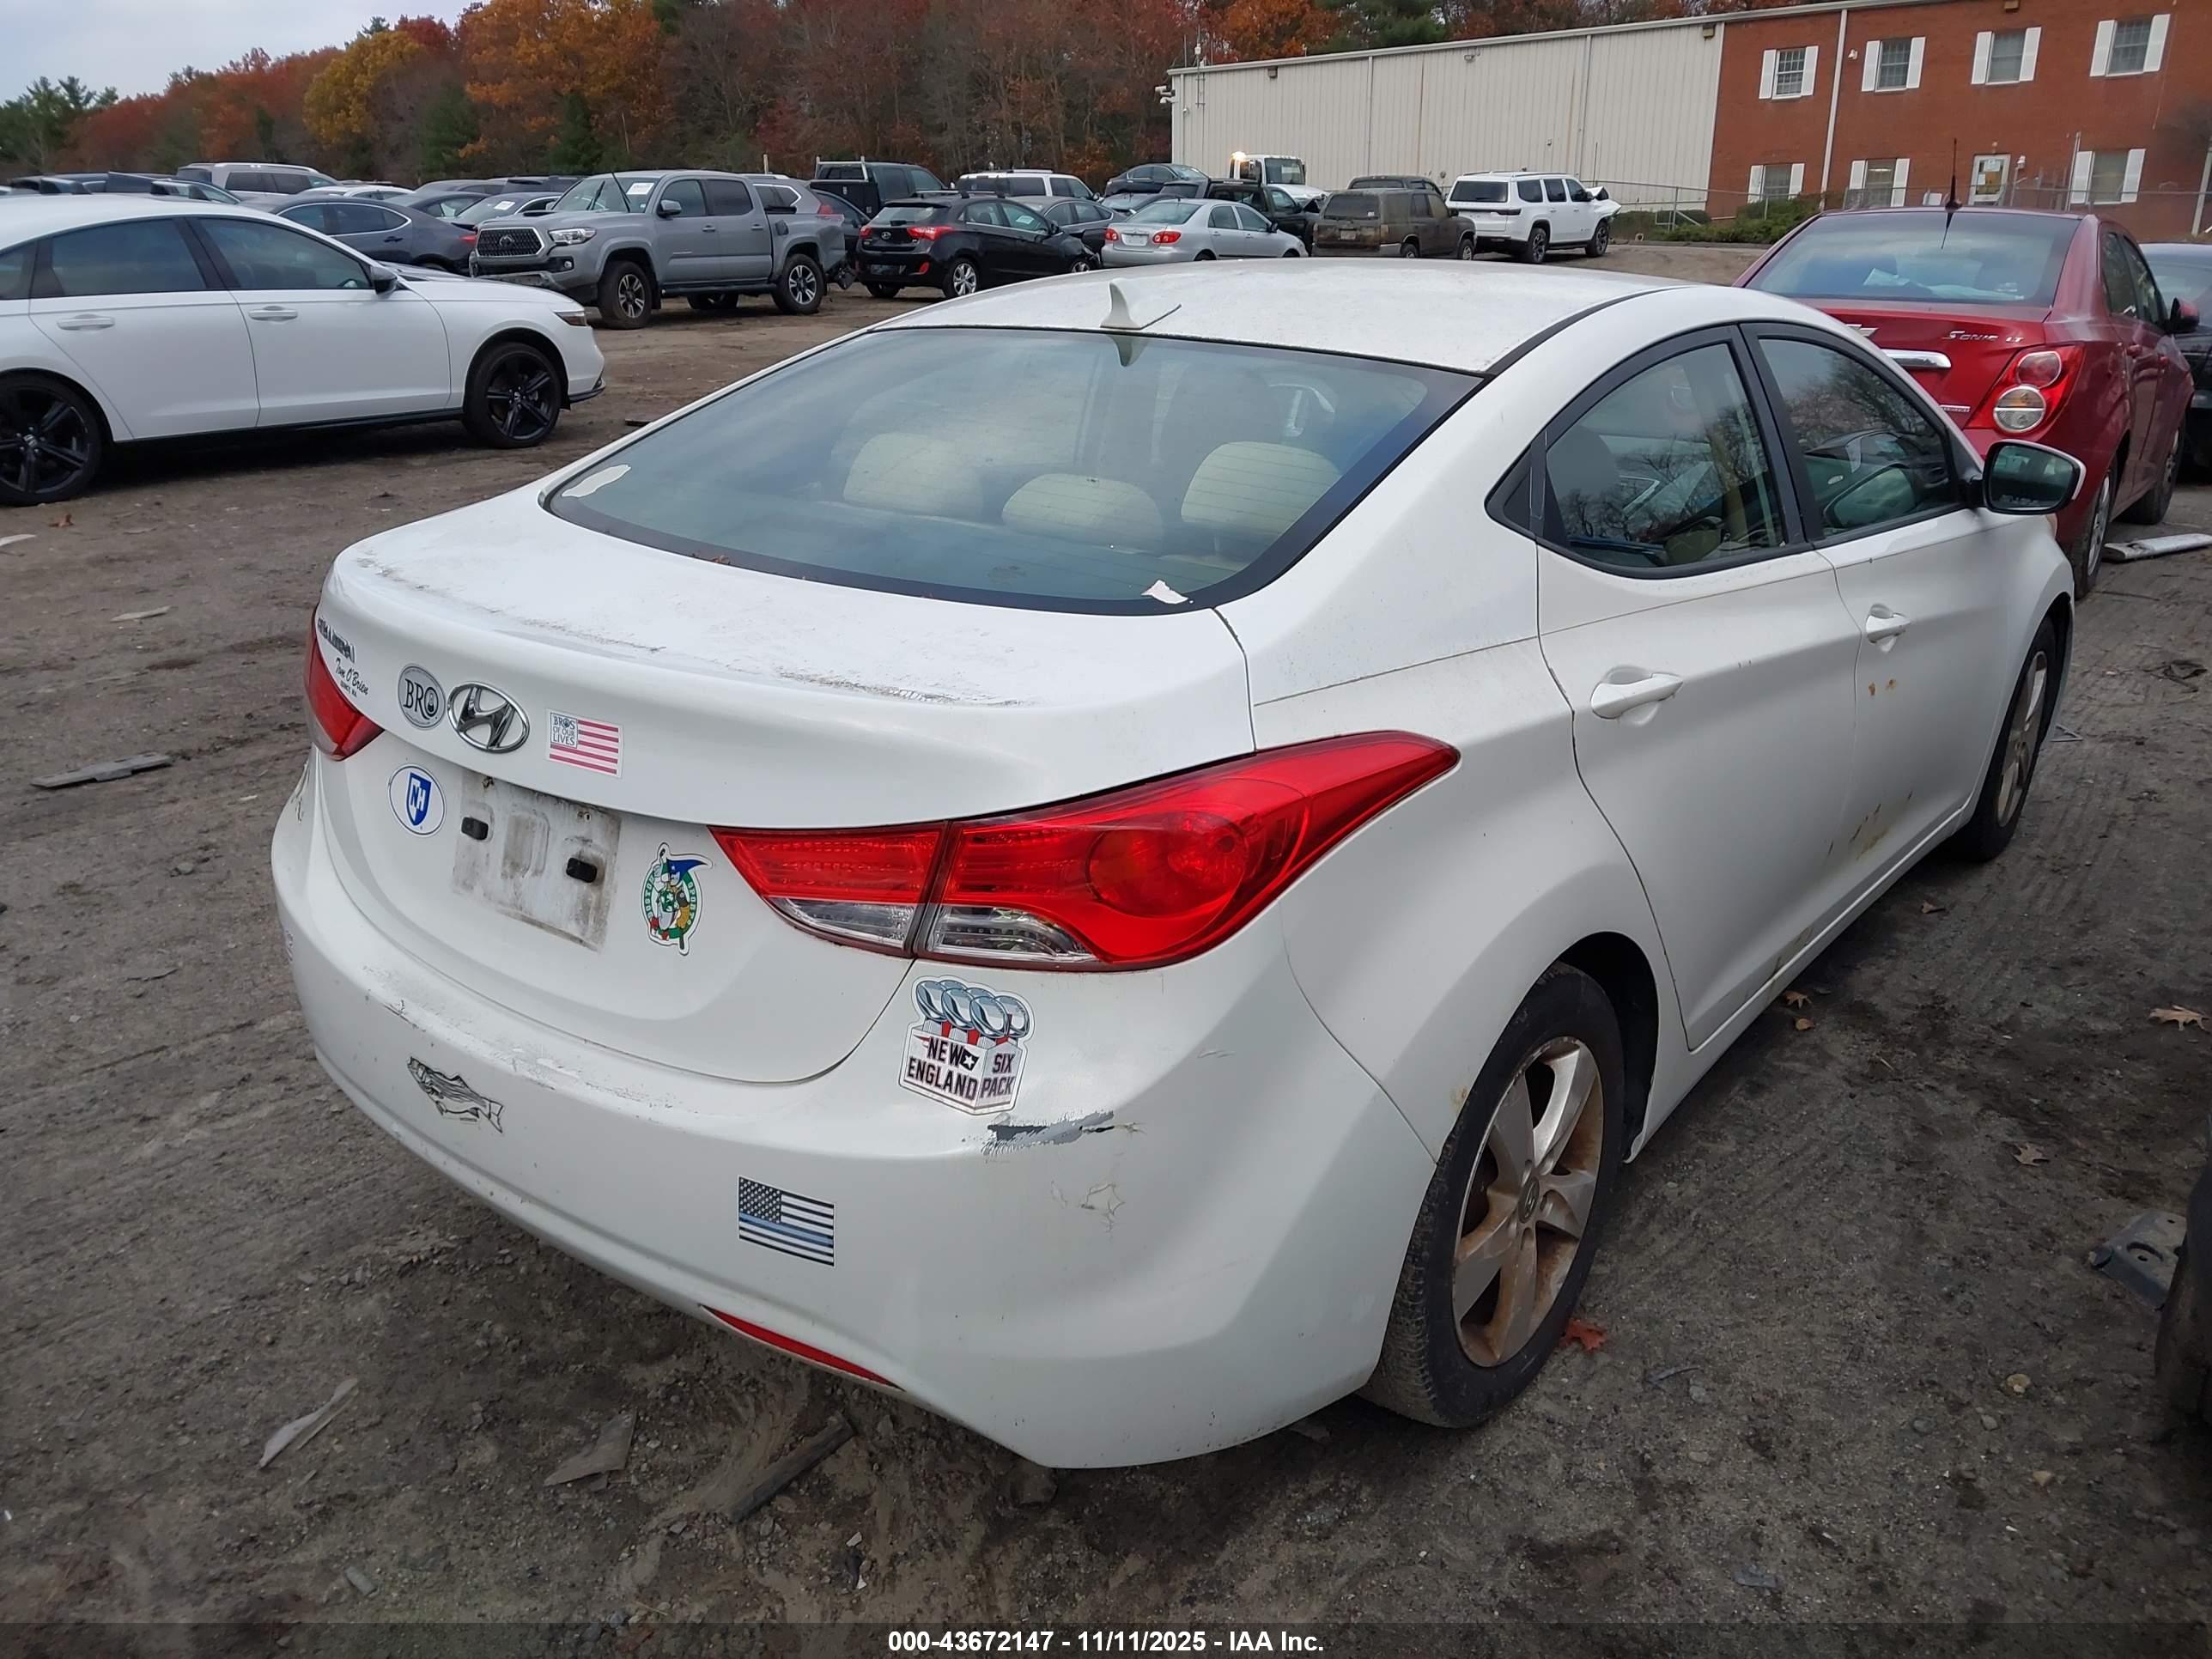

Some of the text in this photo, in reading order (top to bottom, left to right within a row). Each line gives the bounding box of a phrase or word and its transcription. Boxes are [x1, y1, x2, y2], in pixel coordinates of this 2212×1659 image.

[346, 667, 369, 696] O'Brien
[403, 678, 439, 720] BRO
[553, 715, 575, 730] BROS
[562, 727, 575, 737] OUR
[553, 733, 575, 746] LIVES
[927, 1036, 964, 1067] NEW
[992, 1053, 1016, 1073] SIX
[907, 1056, 978, 1101] ENGLAND
[980, 1076, 1016, 1098] PACK
